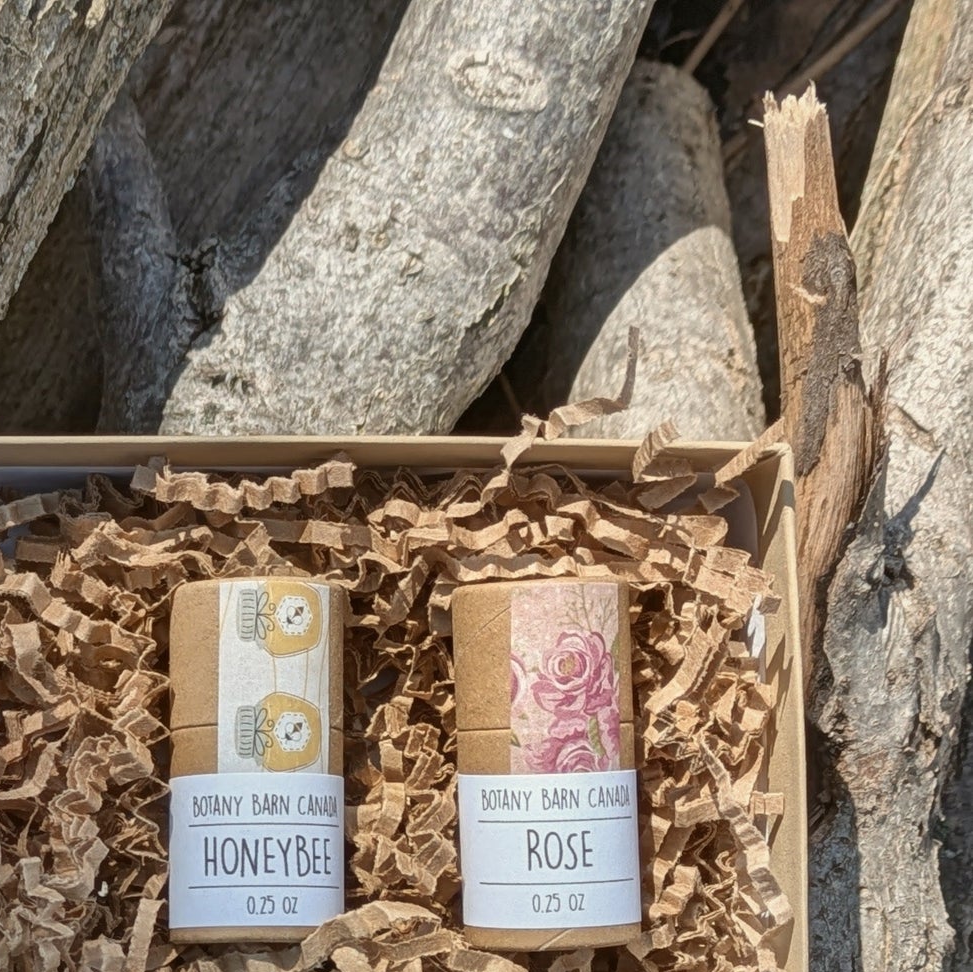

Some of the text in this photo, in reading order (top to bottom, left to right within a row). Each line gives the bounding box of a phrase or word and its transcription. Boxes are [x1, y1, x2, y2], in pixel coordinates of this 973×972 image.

[192, 793, 338, 817] BOTANY BARN CANADA
[481, 785, 630, 811] BOTANY BARN CANADA
[204, 835, 331, 878] HONEYBEE
[527, 829, 593, 871] ROSE
[246, 895, 298, 915] 0.25 OZ
[532, 893, 585, 913] 0.25 OZ
